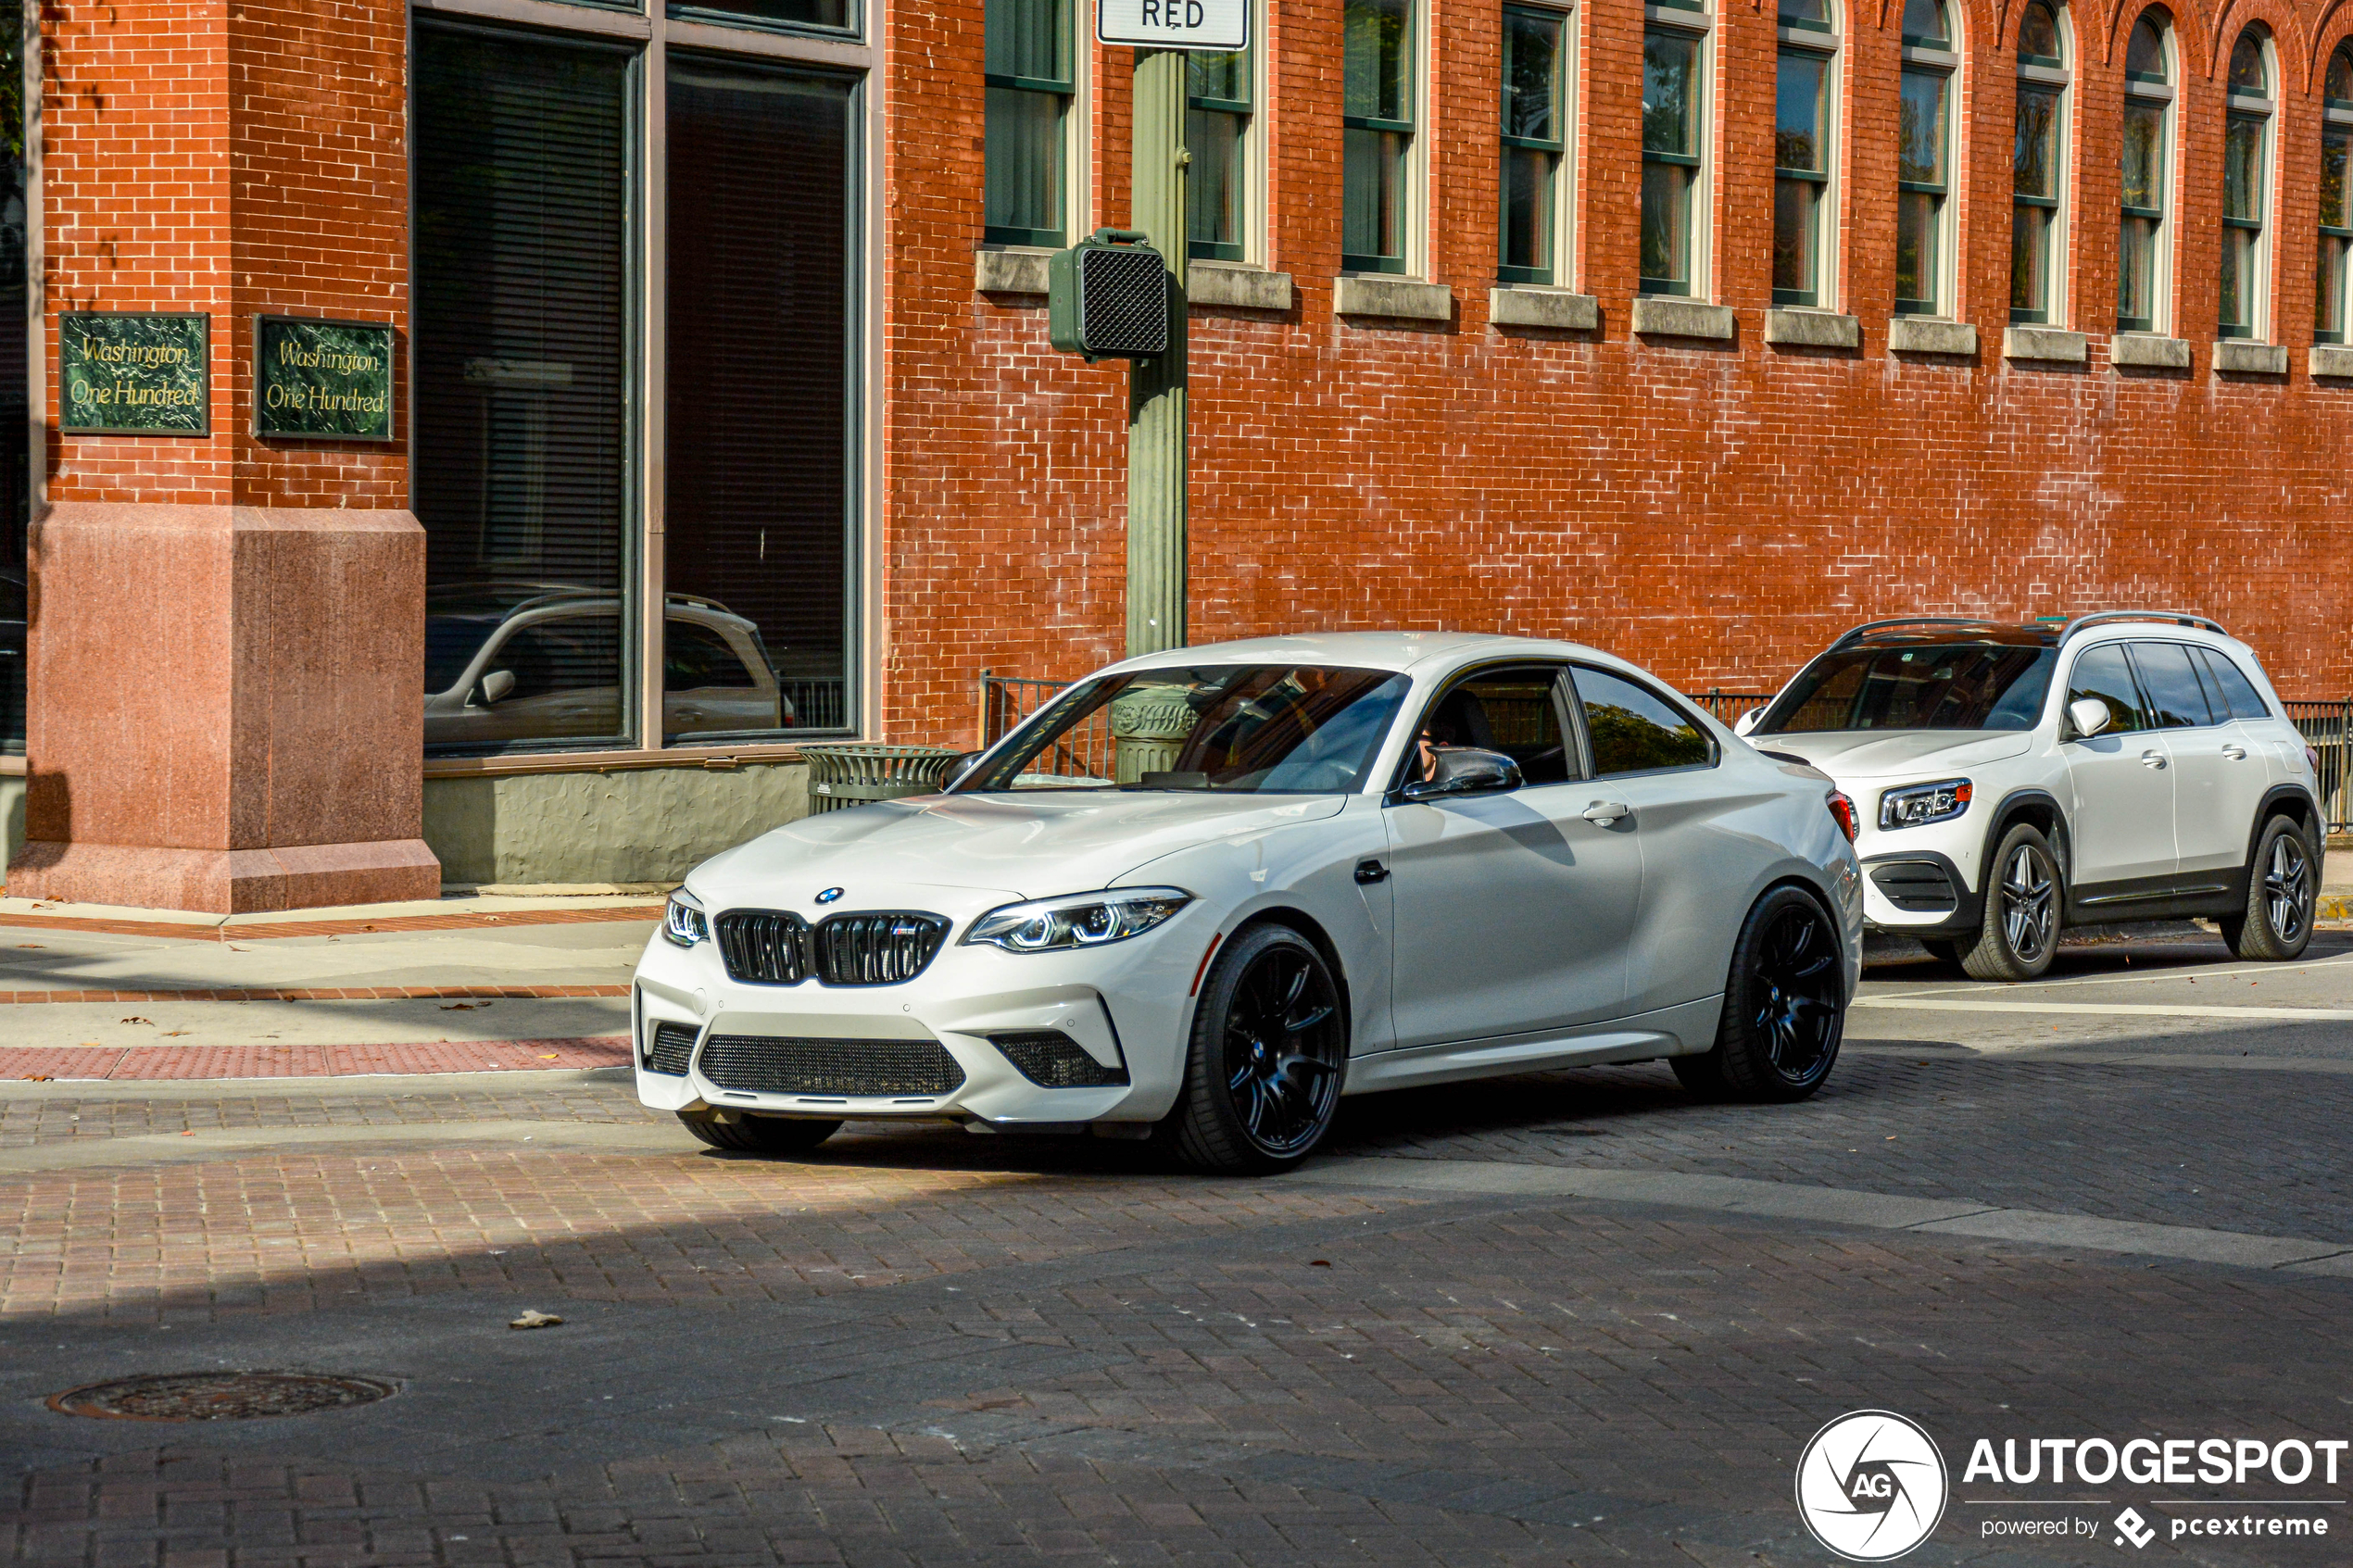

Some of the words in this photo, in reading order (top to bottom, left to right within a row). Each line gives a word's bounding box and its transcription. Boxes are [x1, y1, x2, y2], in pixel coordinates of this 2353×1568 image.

[1142, 0, 1203, 29] RED
[82, 337, 189, 369] Washington
[280, 340, 379, 376] Washington
[70, 379, 111, 405] One
[113, 380, 197, 406] Hundred
[267, 383, 306, 409] One
[308, 385, 384, 413] Hundred
